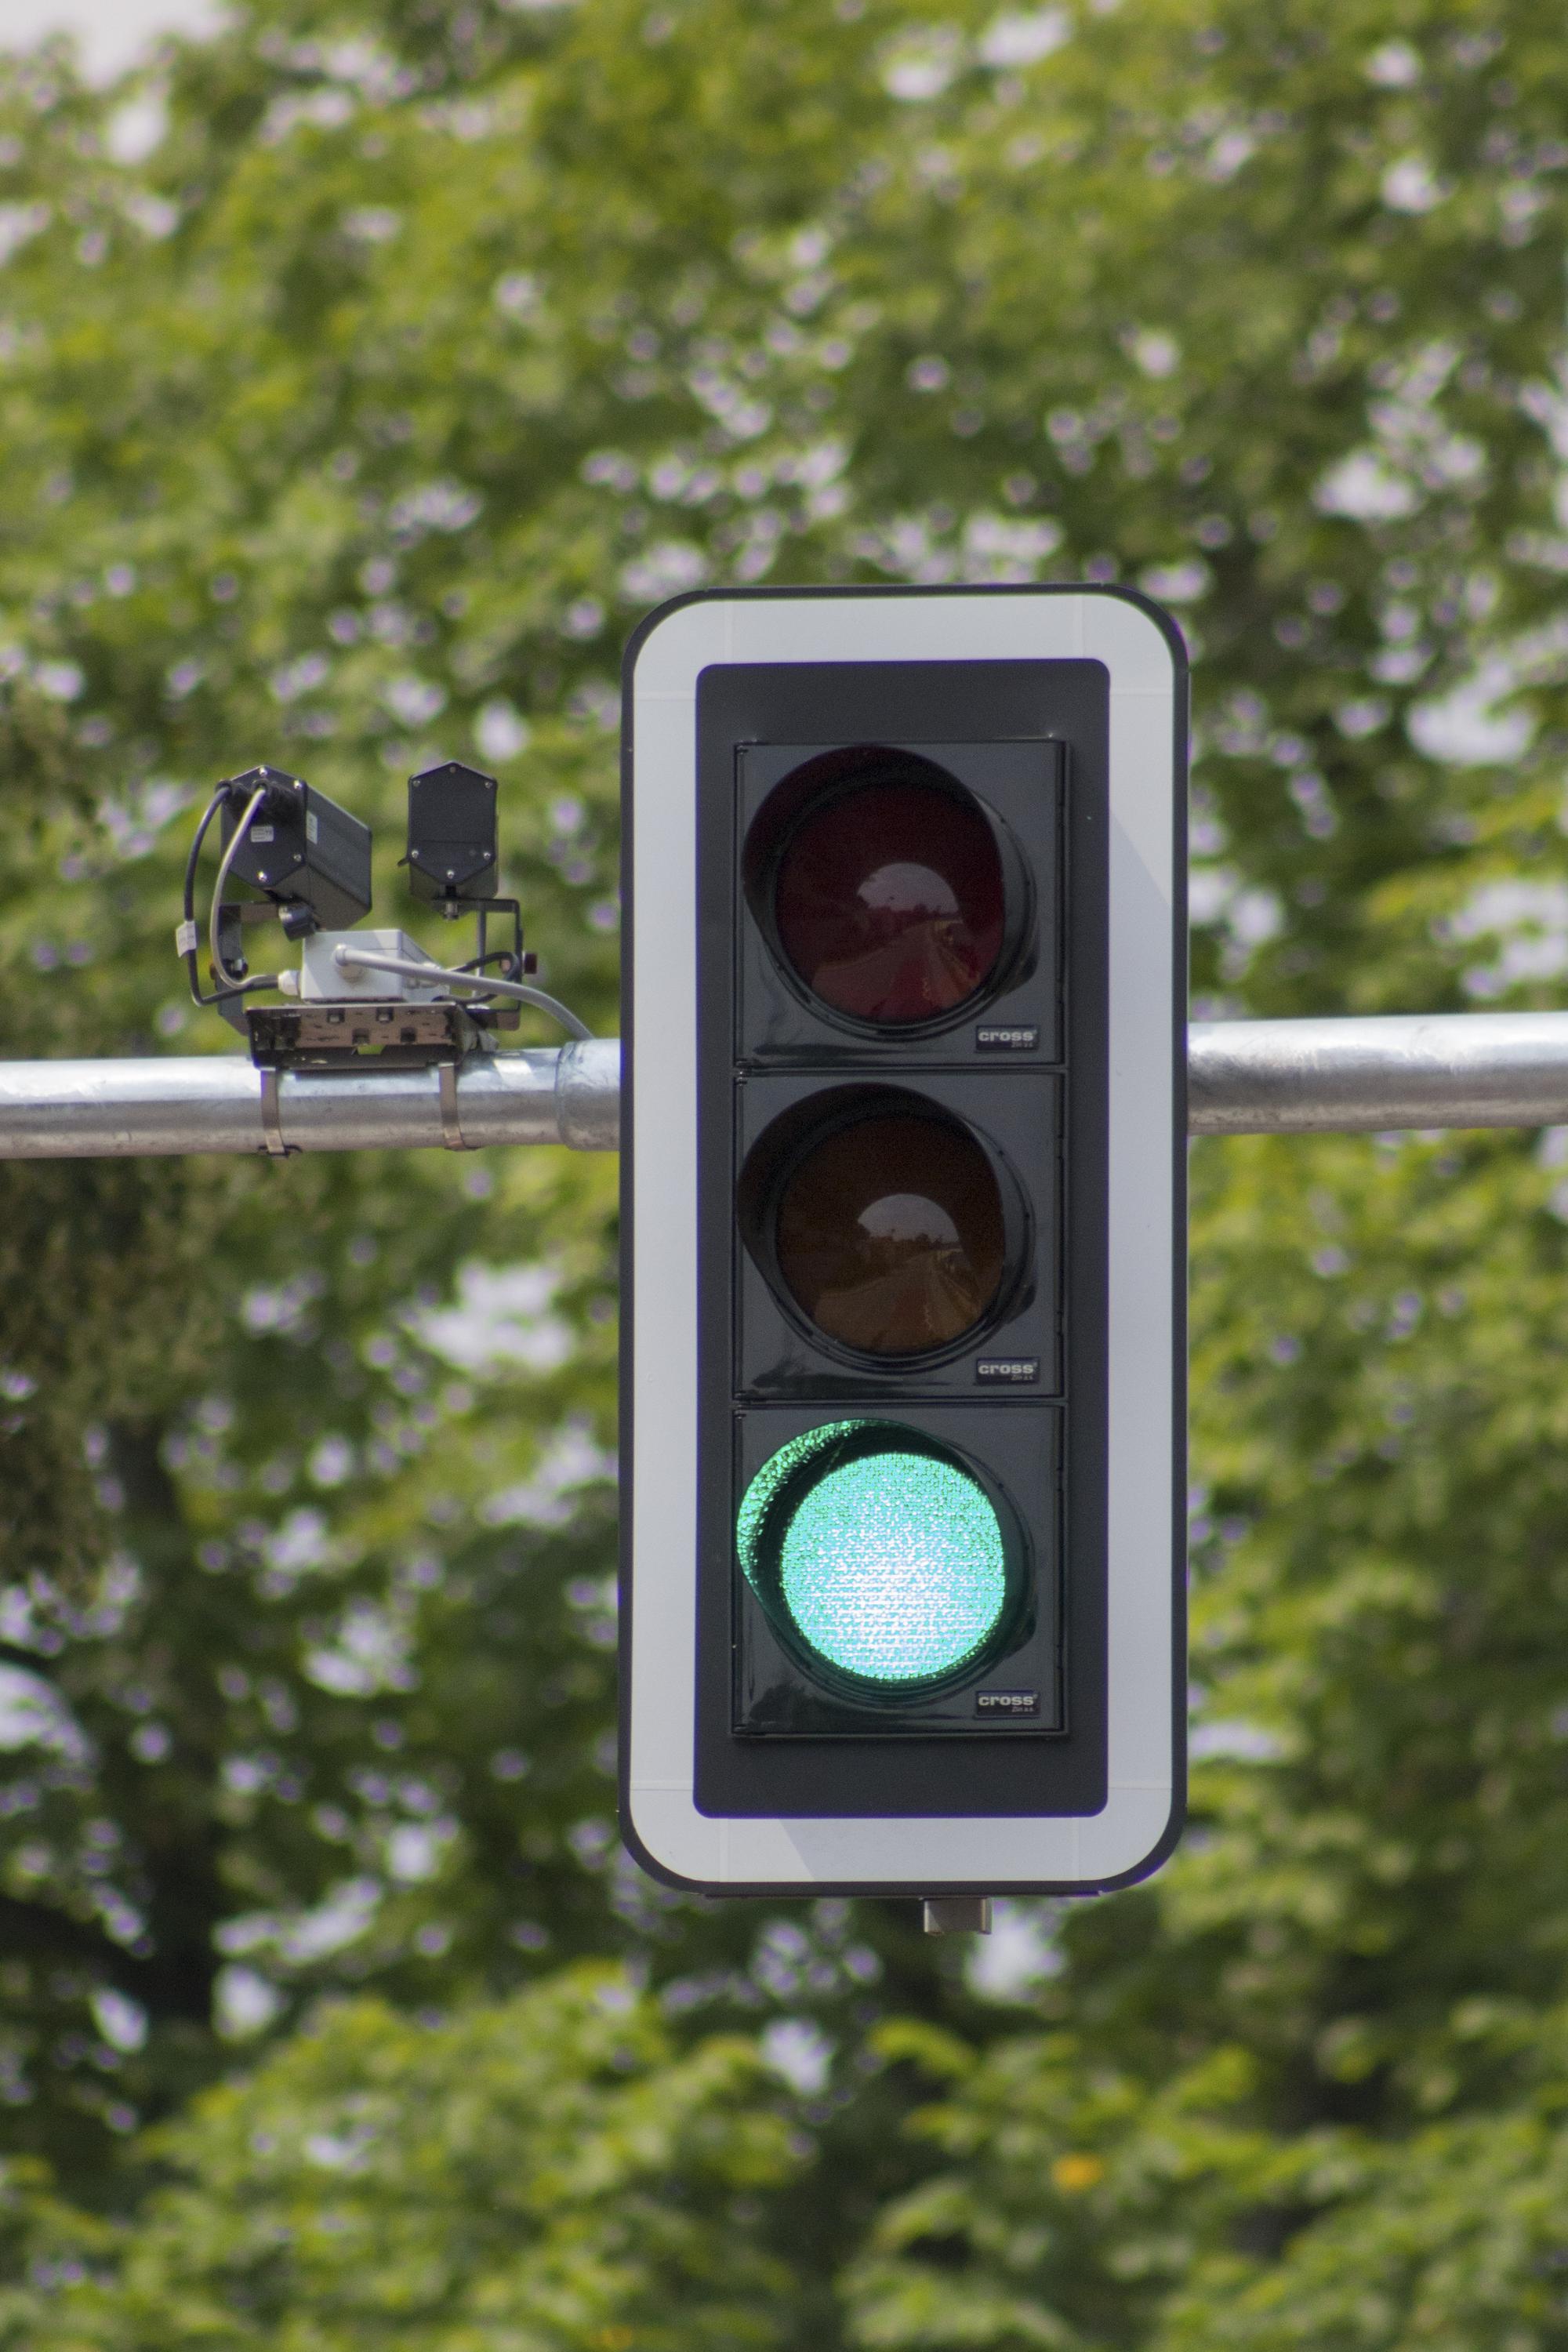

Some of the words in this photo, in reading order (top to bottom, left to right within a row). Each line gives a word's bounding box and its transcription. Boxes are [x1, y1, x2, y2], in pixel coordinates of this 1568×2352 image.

[978, 1032, 1034, 1042] cross
[978, 1365, 1034, 1374] cross
[978, 1696, 1034, 1706] cross
